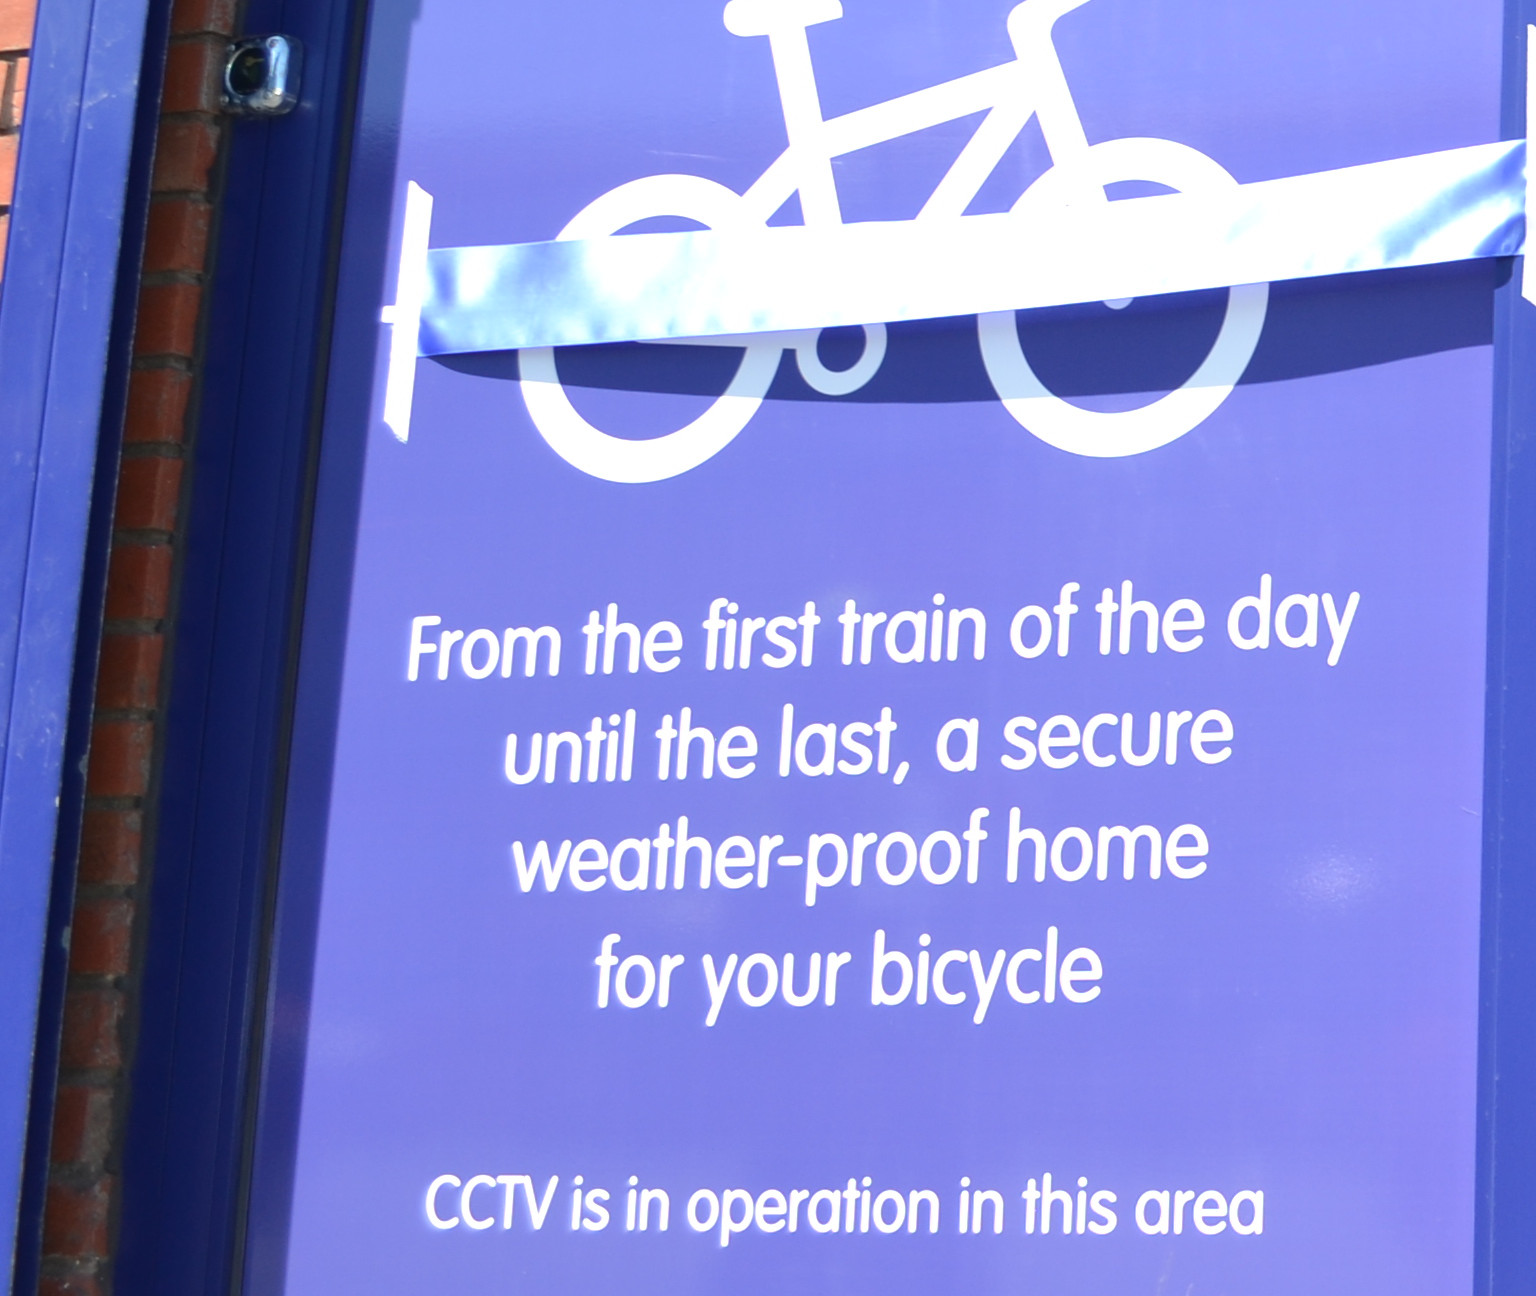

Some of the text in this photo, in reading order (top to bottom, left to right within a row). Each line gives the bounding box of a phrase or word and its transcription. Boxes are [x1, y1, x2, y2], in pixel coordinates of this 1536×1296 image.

[407, 573, 1360, 681] From the first train of the day
[504, 703, 1233, 785] until the last, a secure
[511, 807, 1209, 907] weather-proof home
[594, 926, 1103, 1027] for your bicycle
[424, 1172, 1264, 1247] CCTV is in operation in this area
